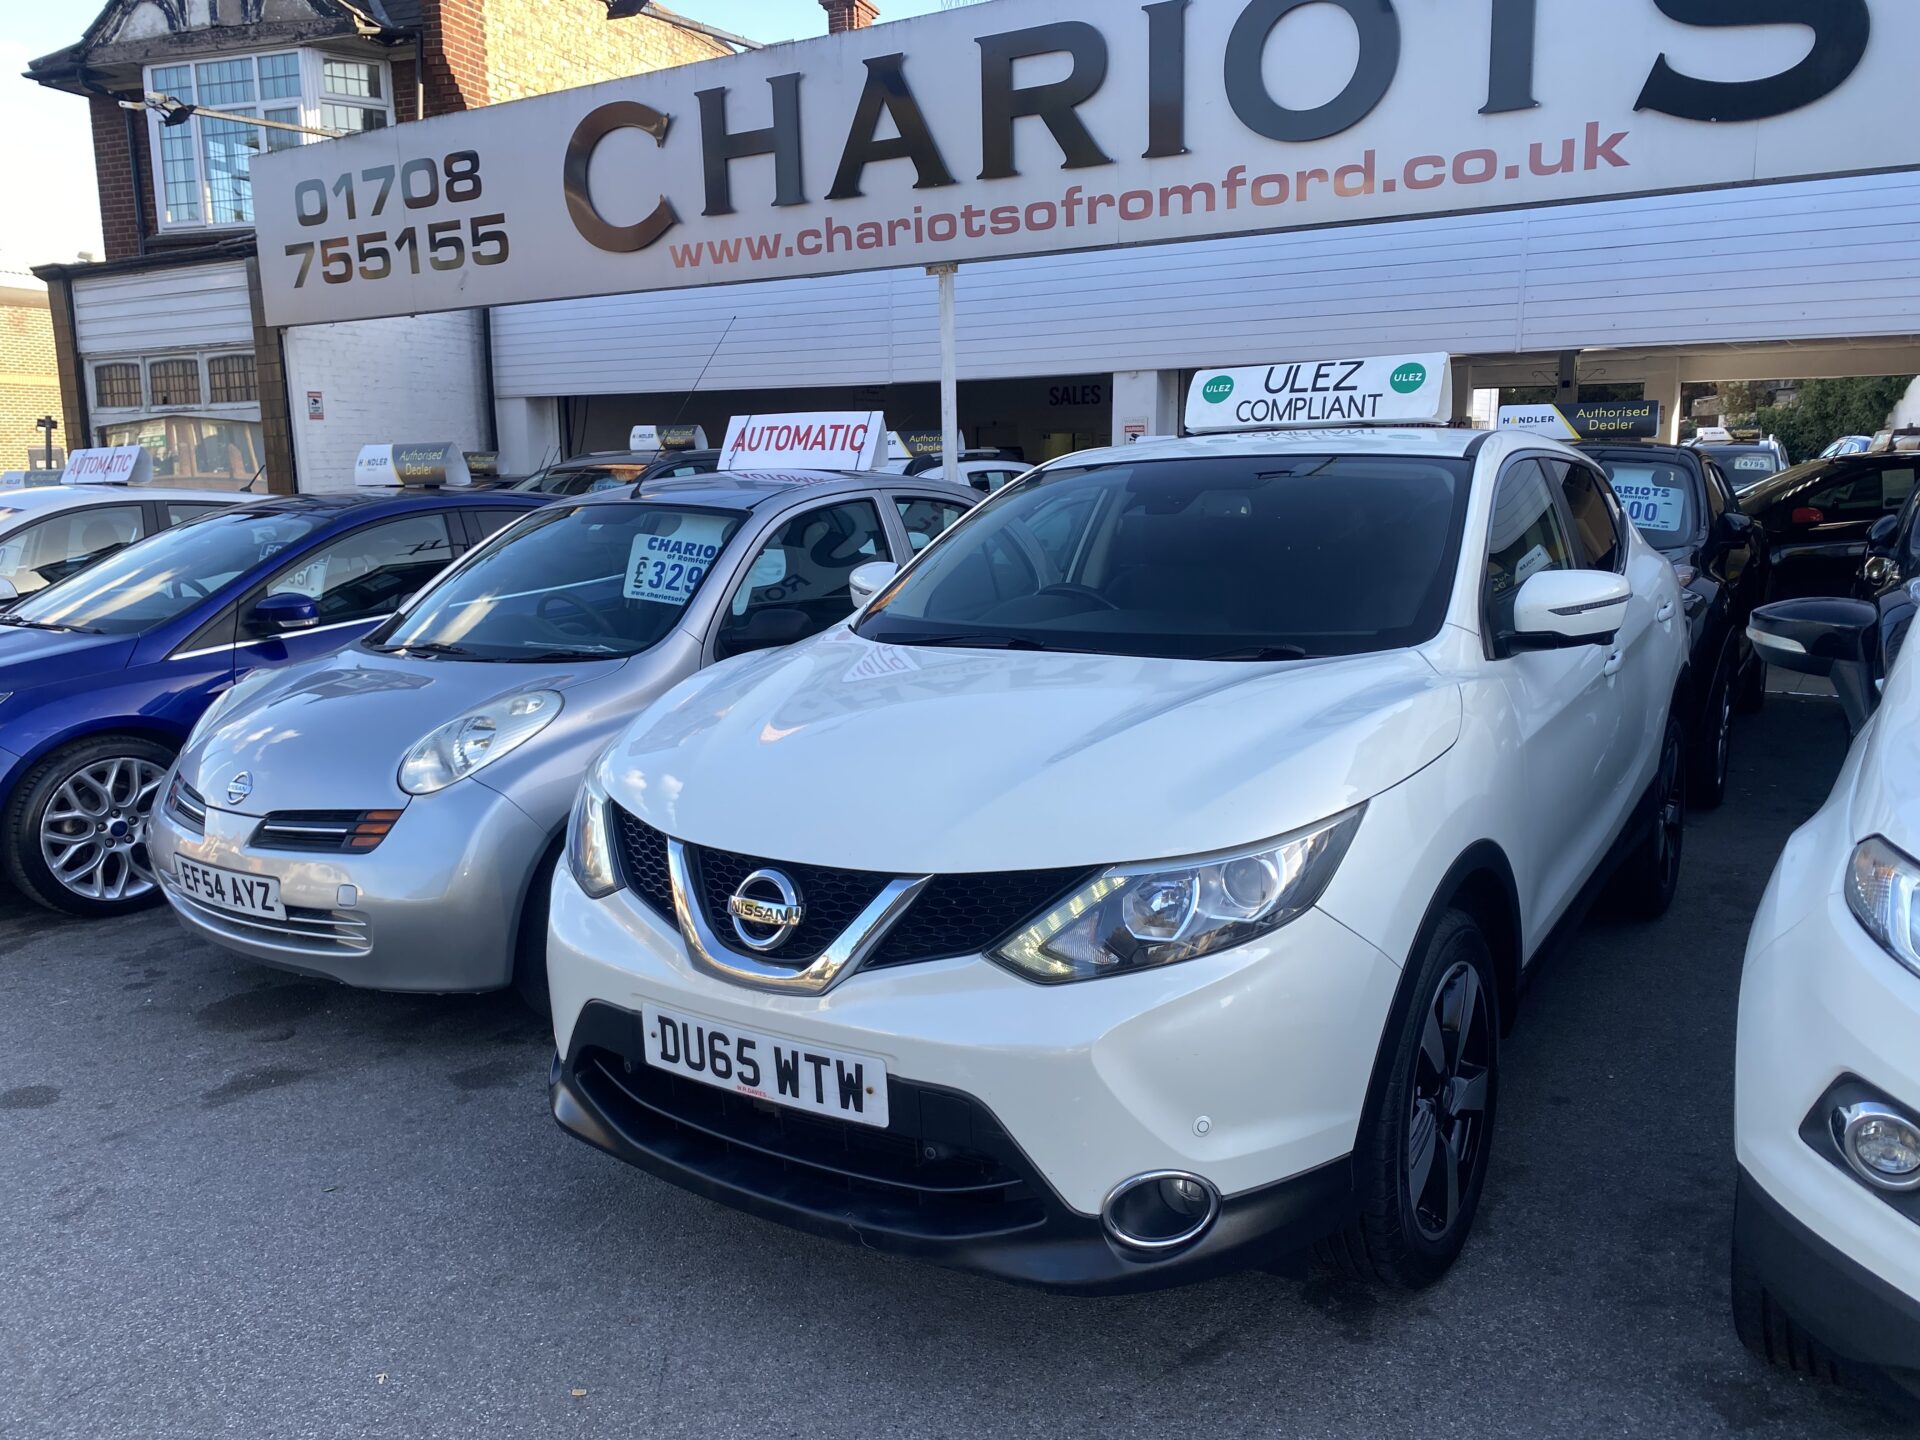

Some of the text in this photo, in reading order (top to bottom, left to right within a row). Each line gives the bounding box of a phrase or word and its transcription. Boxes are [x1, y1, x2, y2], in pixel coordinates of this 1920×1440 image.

[294, 149, 482, 227] 01708
[669, 121, 1632, 269] www.chariotsofromford.co.uk
[284, 212, 509, 289] 755155
[1264, 360, 1365, 395] ULEZ
[1393, 371, 1423, 383] ULEZ
[1049, 384, 1101, 406] SALES
[1206, 384, 1232, 393] ULEZ
[1235, 393, 1383, 423] COMPLIANT
[1576, 405, 1650, 419] Authorised
[1588, 419, 1634, 431] Dealer
[730, 424, 868, 453] AUTOMATIC
[916, 443, 943, 452] Deale
[69, 454, 133, 475] AUTOMATIC
[400, 447, 444, 462] Authorised
[405, 463, 432, 476] Dealer
[647, 536, 719, 559] CHARIO
[181, 862, 275, 912] EF54 AYZ
[731, 900, 789, 921] NISSAN
[657, 1014, 864, 1113] DU65 WTW
